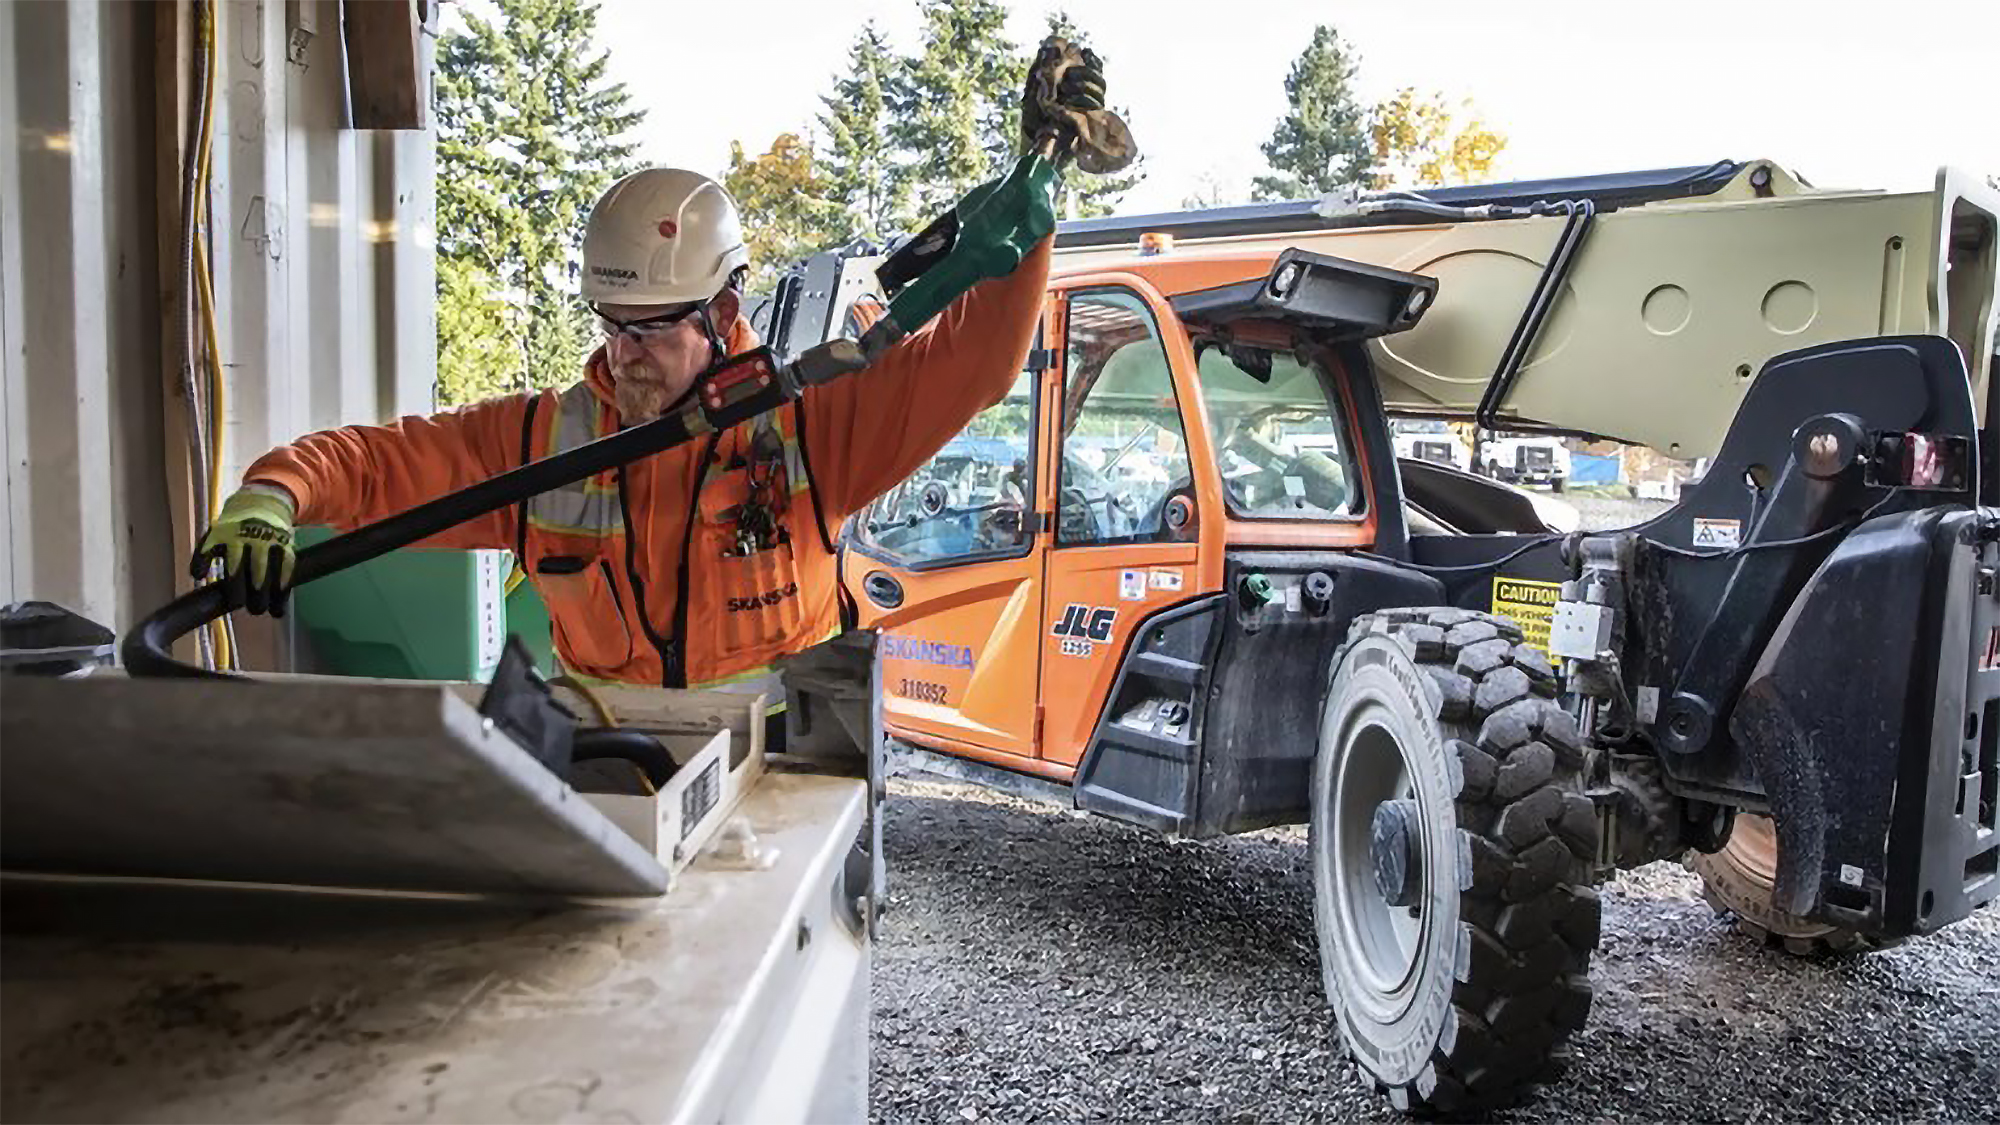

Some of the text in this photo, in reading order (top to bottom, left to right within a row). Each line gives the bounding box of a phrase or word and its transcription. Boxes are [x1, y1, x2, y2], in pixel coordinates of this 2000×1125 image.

[1053, 605, 1116, 641] JLG
[884, 635, 972, 668] SKANSKA
[898, 678, 949, 706] 310352
